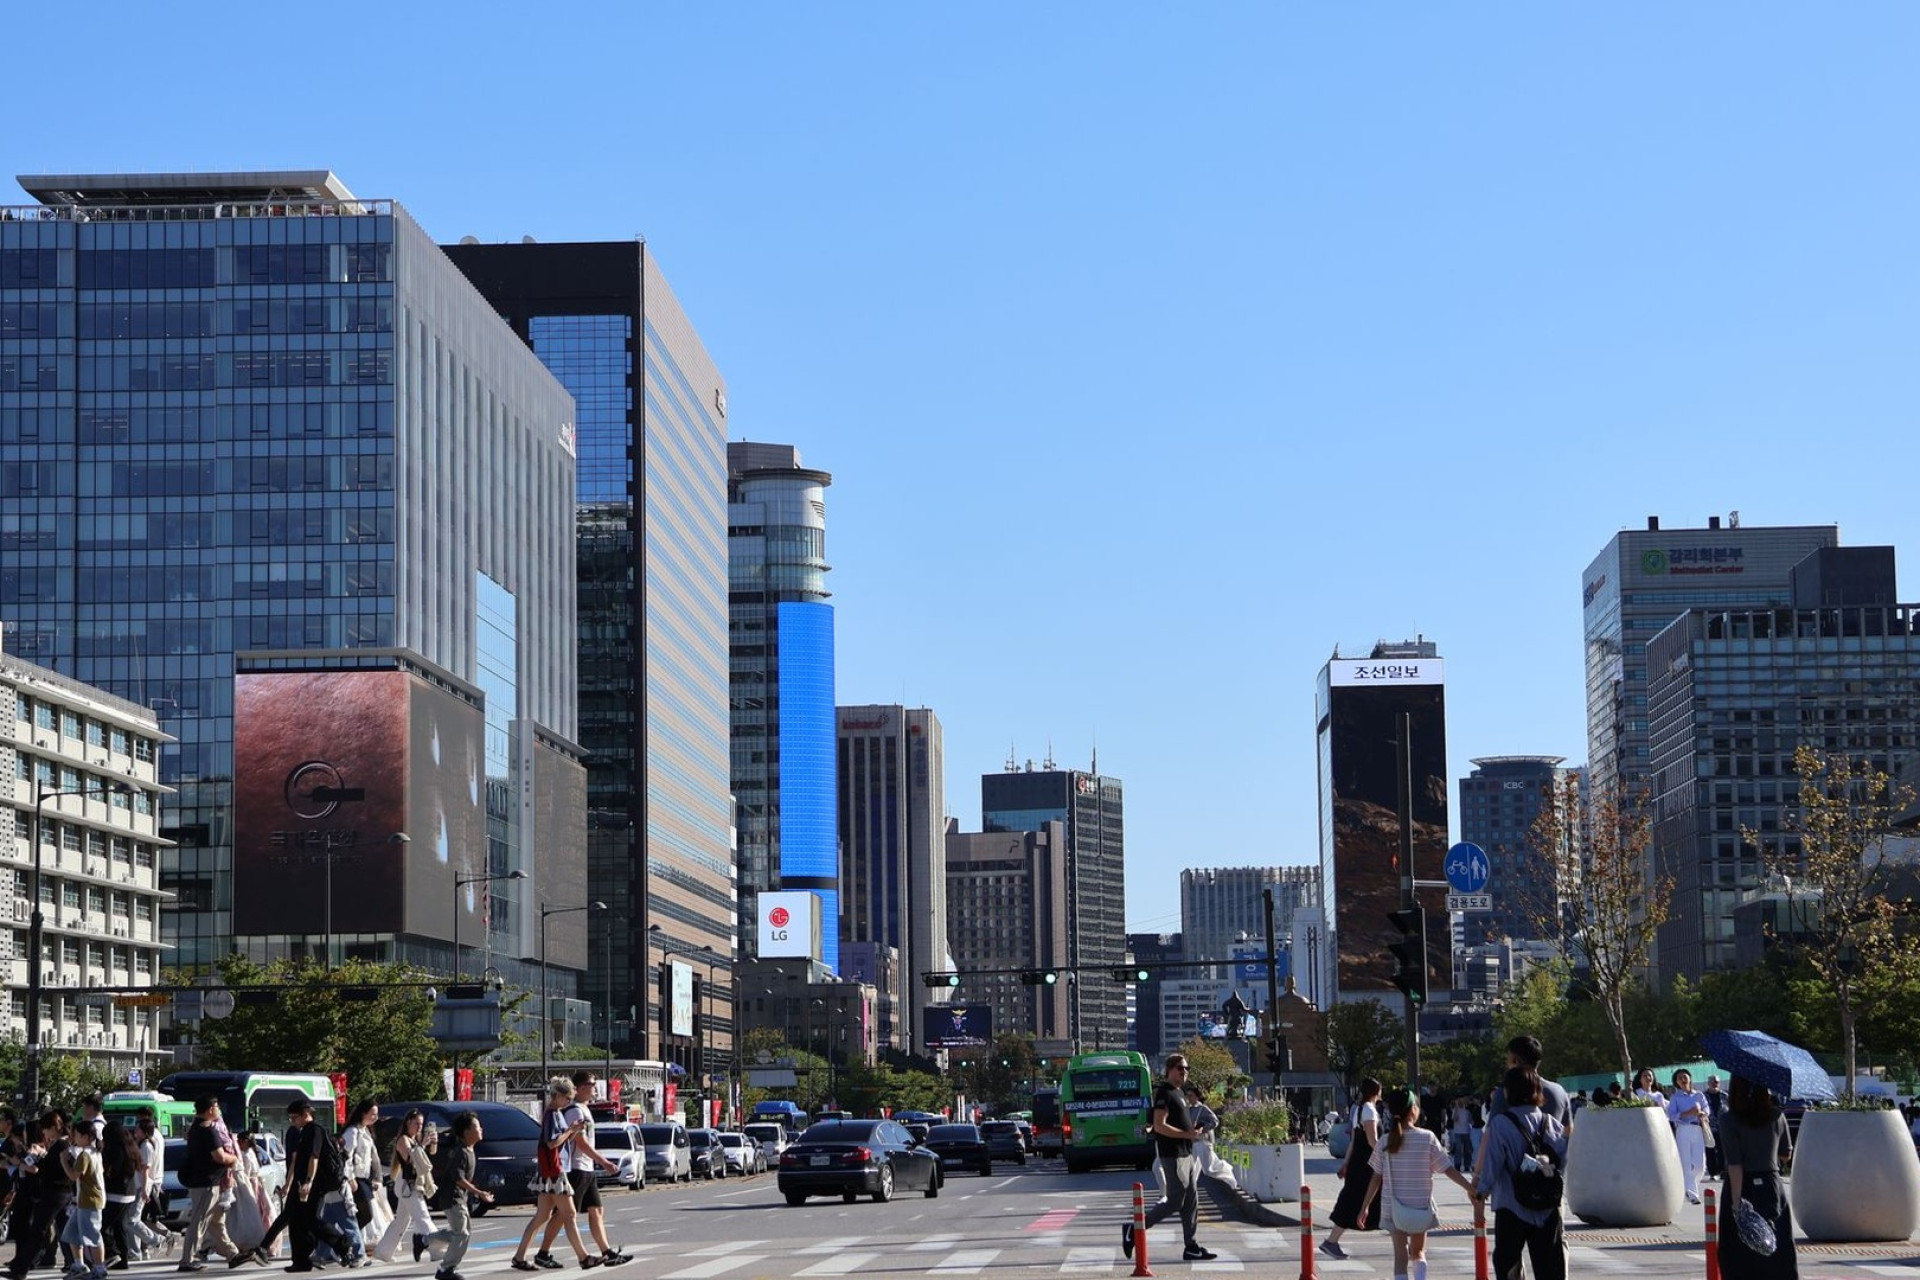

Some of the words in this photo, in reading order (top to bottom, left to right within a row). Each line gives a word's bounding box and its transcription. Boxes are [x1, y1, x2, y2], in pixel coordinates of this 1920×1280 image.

[1669, 547, 1743, 563] 감리회본부
[1354, 665, 1420, 679] 조선일보
[1450, 897, 1488, 908] 겸용도로
[771, 930, 788, 941] LG
[1118, 1080, 1137, 1089] 7212
